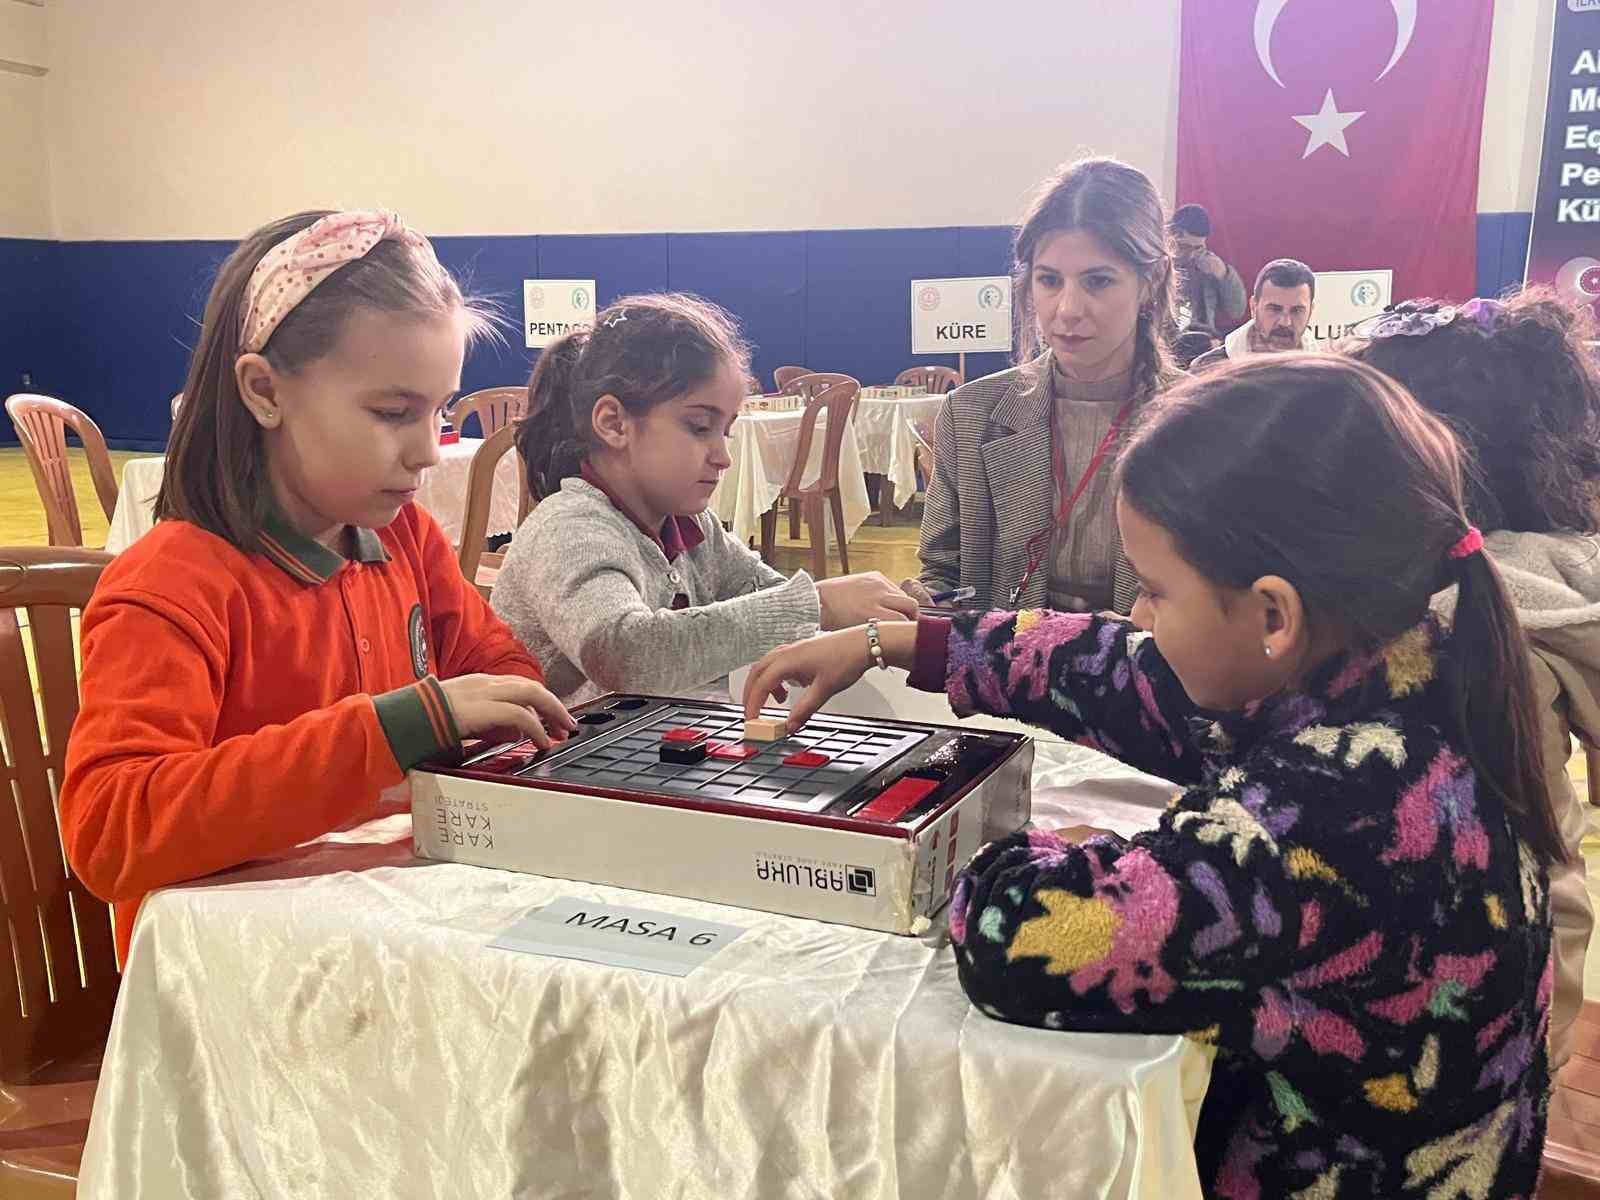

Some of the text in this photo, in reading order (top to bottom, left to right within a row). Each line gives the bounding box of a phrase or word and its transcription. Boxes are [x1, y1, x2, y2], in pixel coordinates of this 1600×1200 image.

[936, 322, 986, 340] KÜRE
[436, 808, 491, 831] KARE
[440, 827, 494, 849] KARE
[756, 859, 843, 891] ABLUKA
[565, 912, 717, 945] MASA 6
